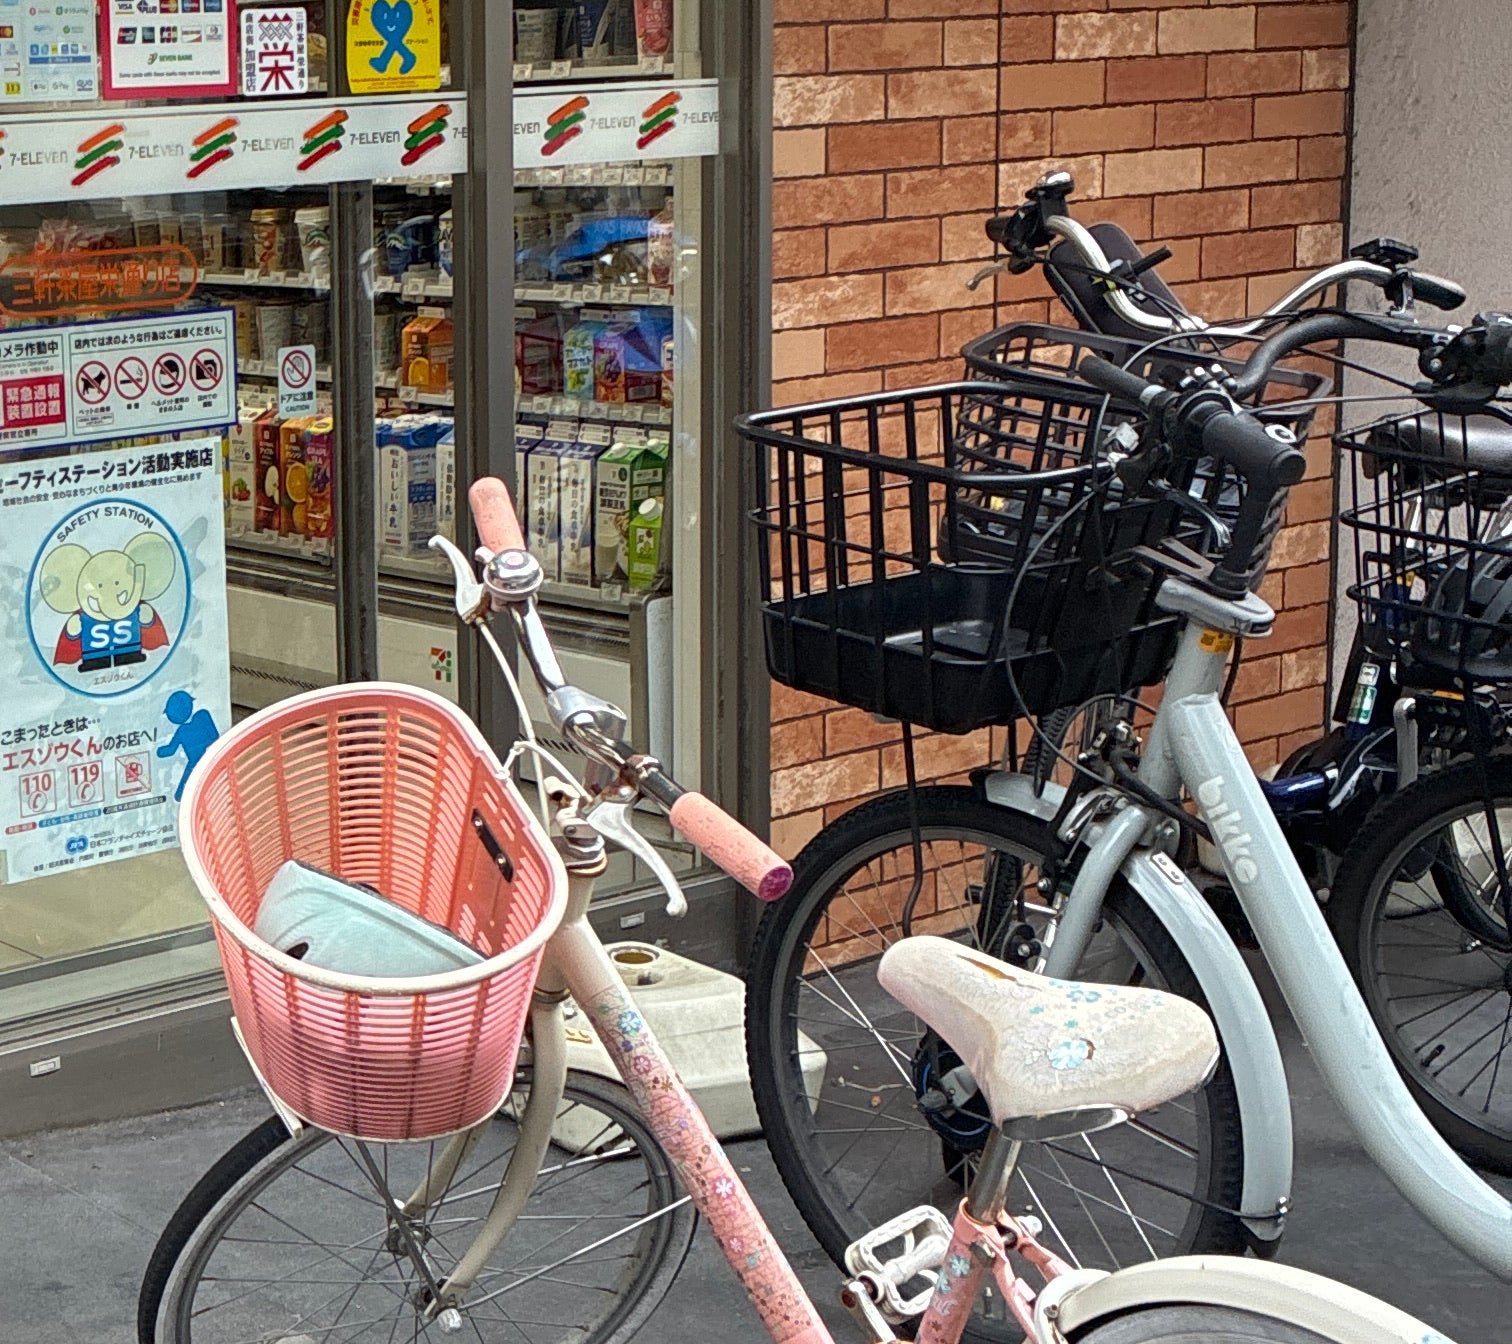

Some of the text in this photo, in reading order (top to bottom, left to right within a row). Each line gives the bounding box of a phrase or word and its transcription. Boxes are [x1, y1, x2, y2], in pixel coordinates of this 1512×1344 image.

[141, 5, 157, 14] PLUS
[258, 42, 295, 92] 栄
[11, 258, 181, 306] 三軒茶屋栄通り店
[280, 392, 314, 404] ドアに注意
[285, 404, 310, 413] CAUTION
[390, 457, 399, 528] おいしい牛乳
[57, 506, 154, 543] SAFETY STATION
[89, 620, 133, 649] SS
[22, 763, 100, 796] 110 119
[1198, 775, 1258, 884] bikke
